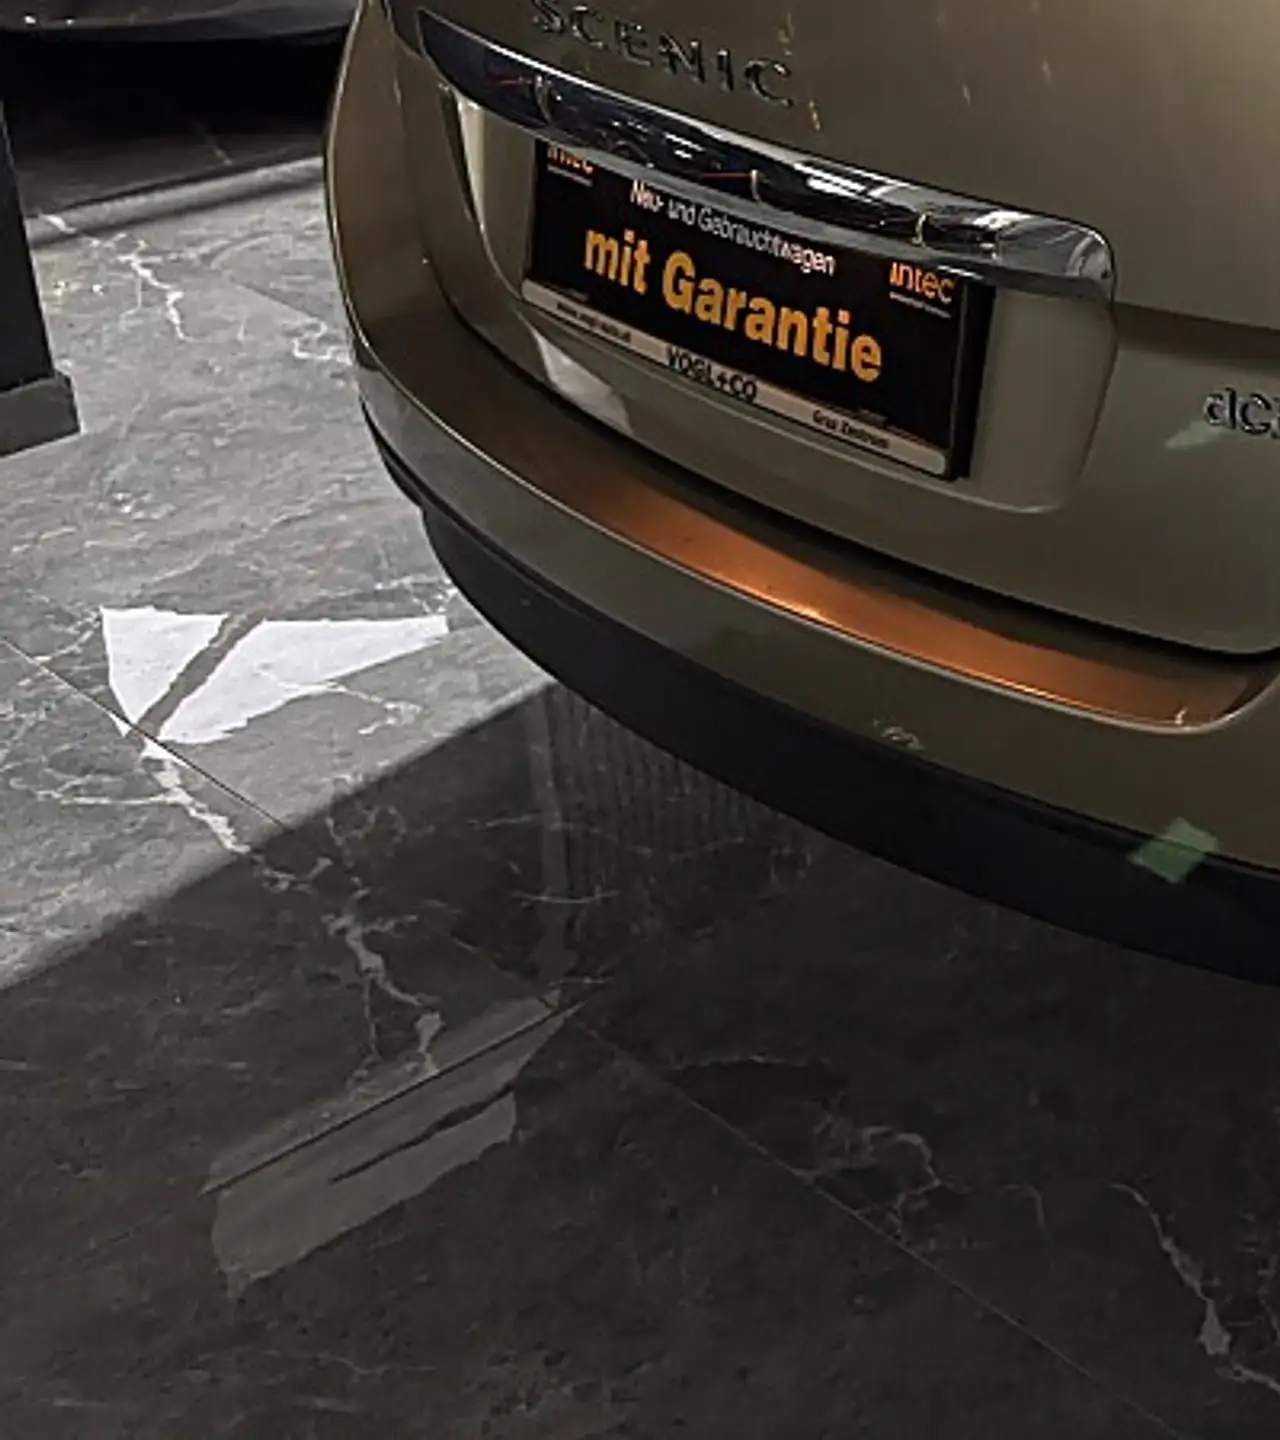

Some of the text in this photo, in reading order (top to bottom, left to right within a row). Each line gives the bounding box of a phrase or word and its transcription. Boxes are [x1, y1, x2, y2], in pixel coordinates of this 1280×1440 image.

[668, 199, 696, 226] und
[697, 207, 836, 277] Gebrauchtwagen
[584, 228, 650, 296] mit
[662, 250, 882, 383] Garantie
[889, 261, 955, 305] intec
[666, 344, 757, 402] VOGL+CO
